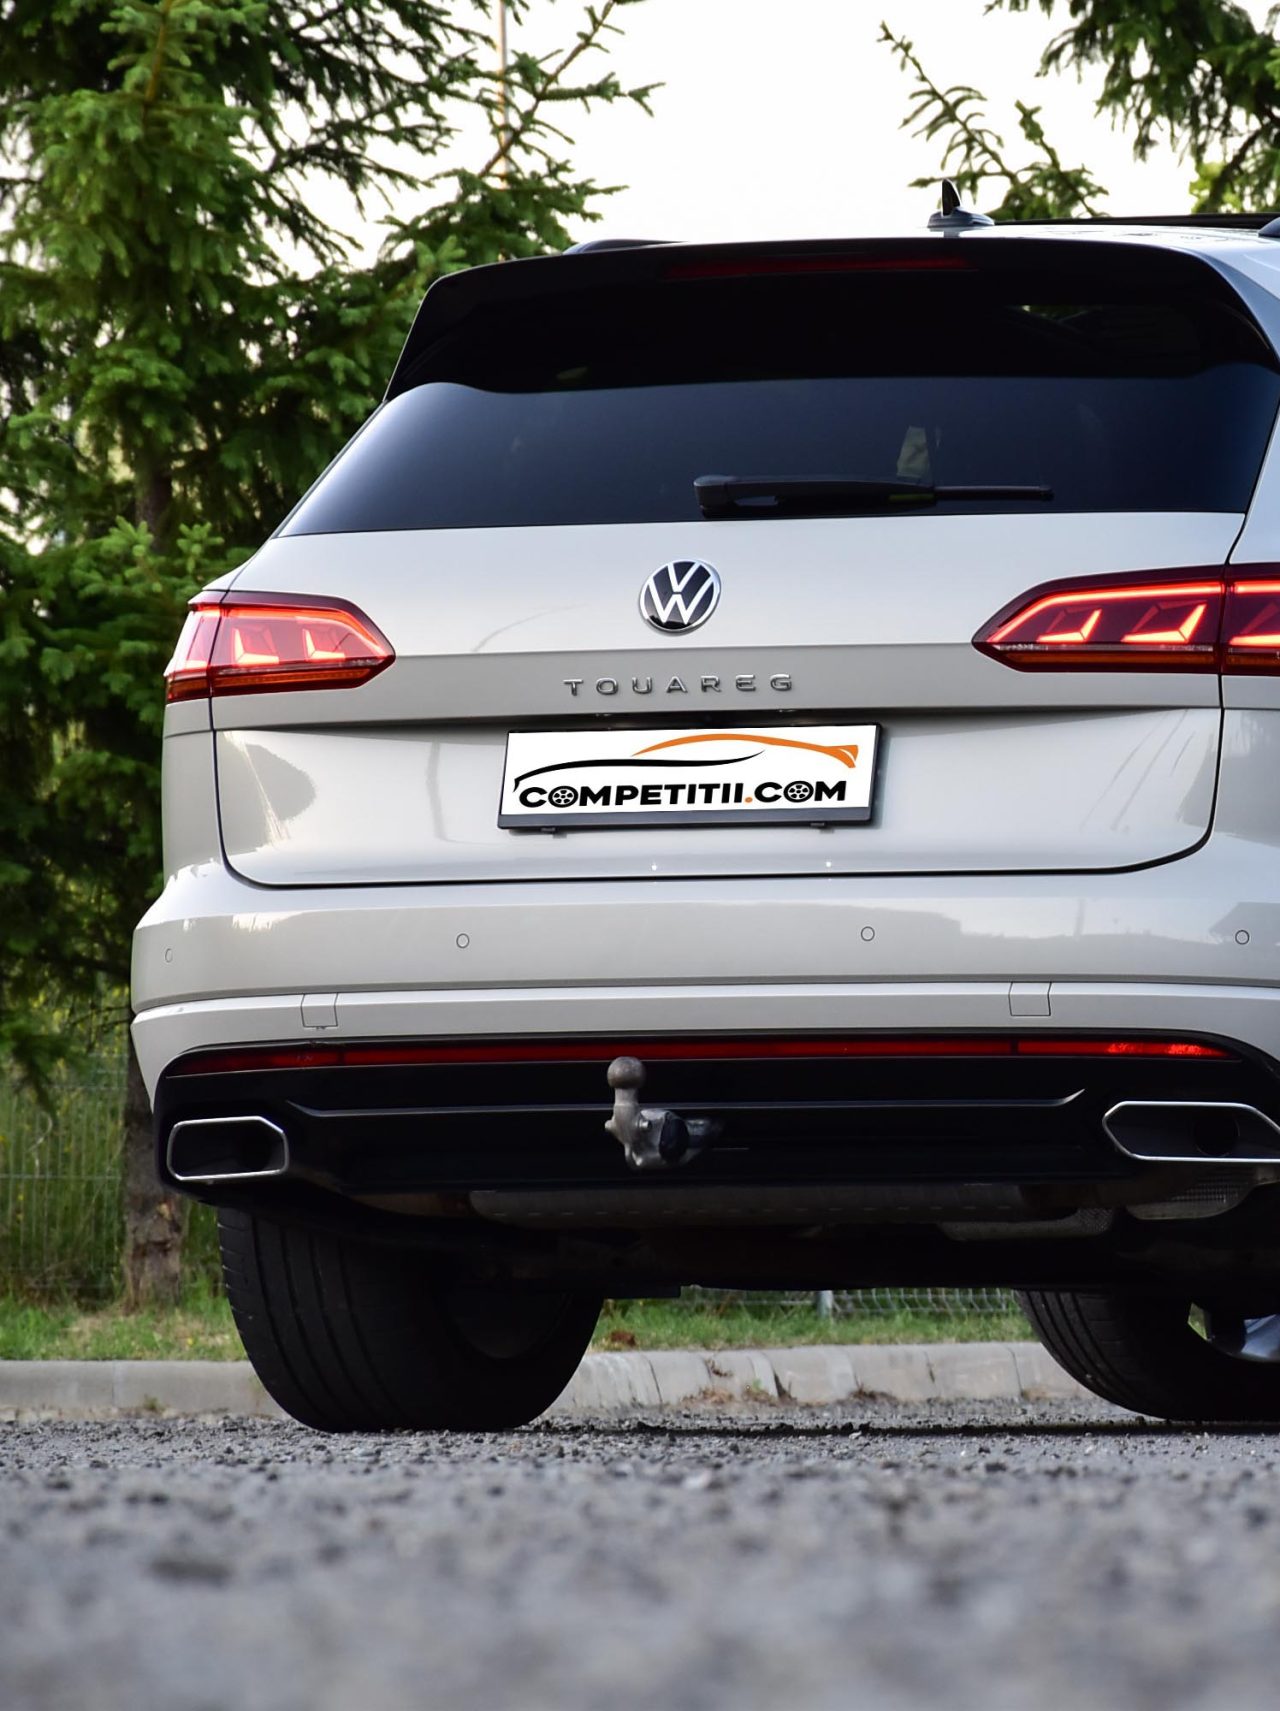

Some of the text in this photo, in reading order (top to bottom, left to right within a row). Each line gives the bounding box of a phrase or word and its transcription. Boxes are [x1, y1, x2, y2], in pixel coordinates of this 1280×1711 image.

[645, 559, 720, 629] VW
[564, 673, 793, 696] TOUAREG
[518, 780, 847, 808] COMPETITII.COM
